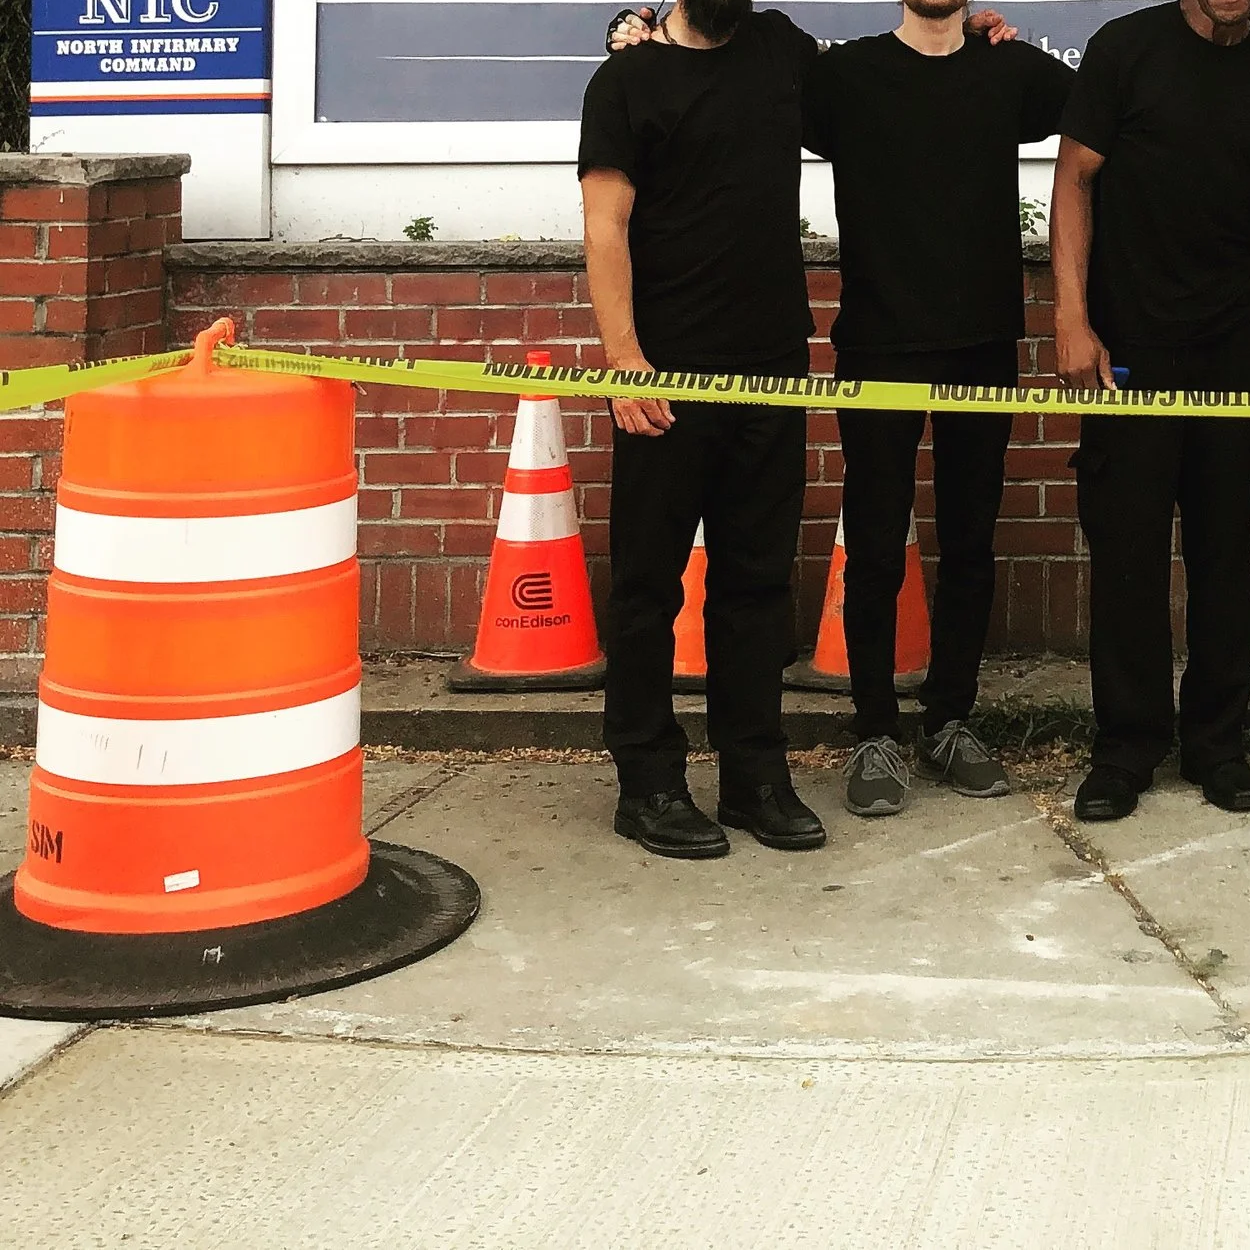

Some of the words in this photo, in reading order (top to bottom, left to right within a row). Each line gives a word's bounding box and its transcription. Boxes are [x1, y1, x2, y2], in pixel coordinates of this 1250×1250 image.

[56, 39, 123, 55] NORTH
[130, 38, 240, 54] INFIRMARY
[100, 57, 196, 73] COMMAND
[495, 614, 571, 628] conEdison
